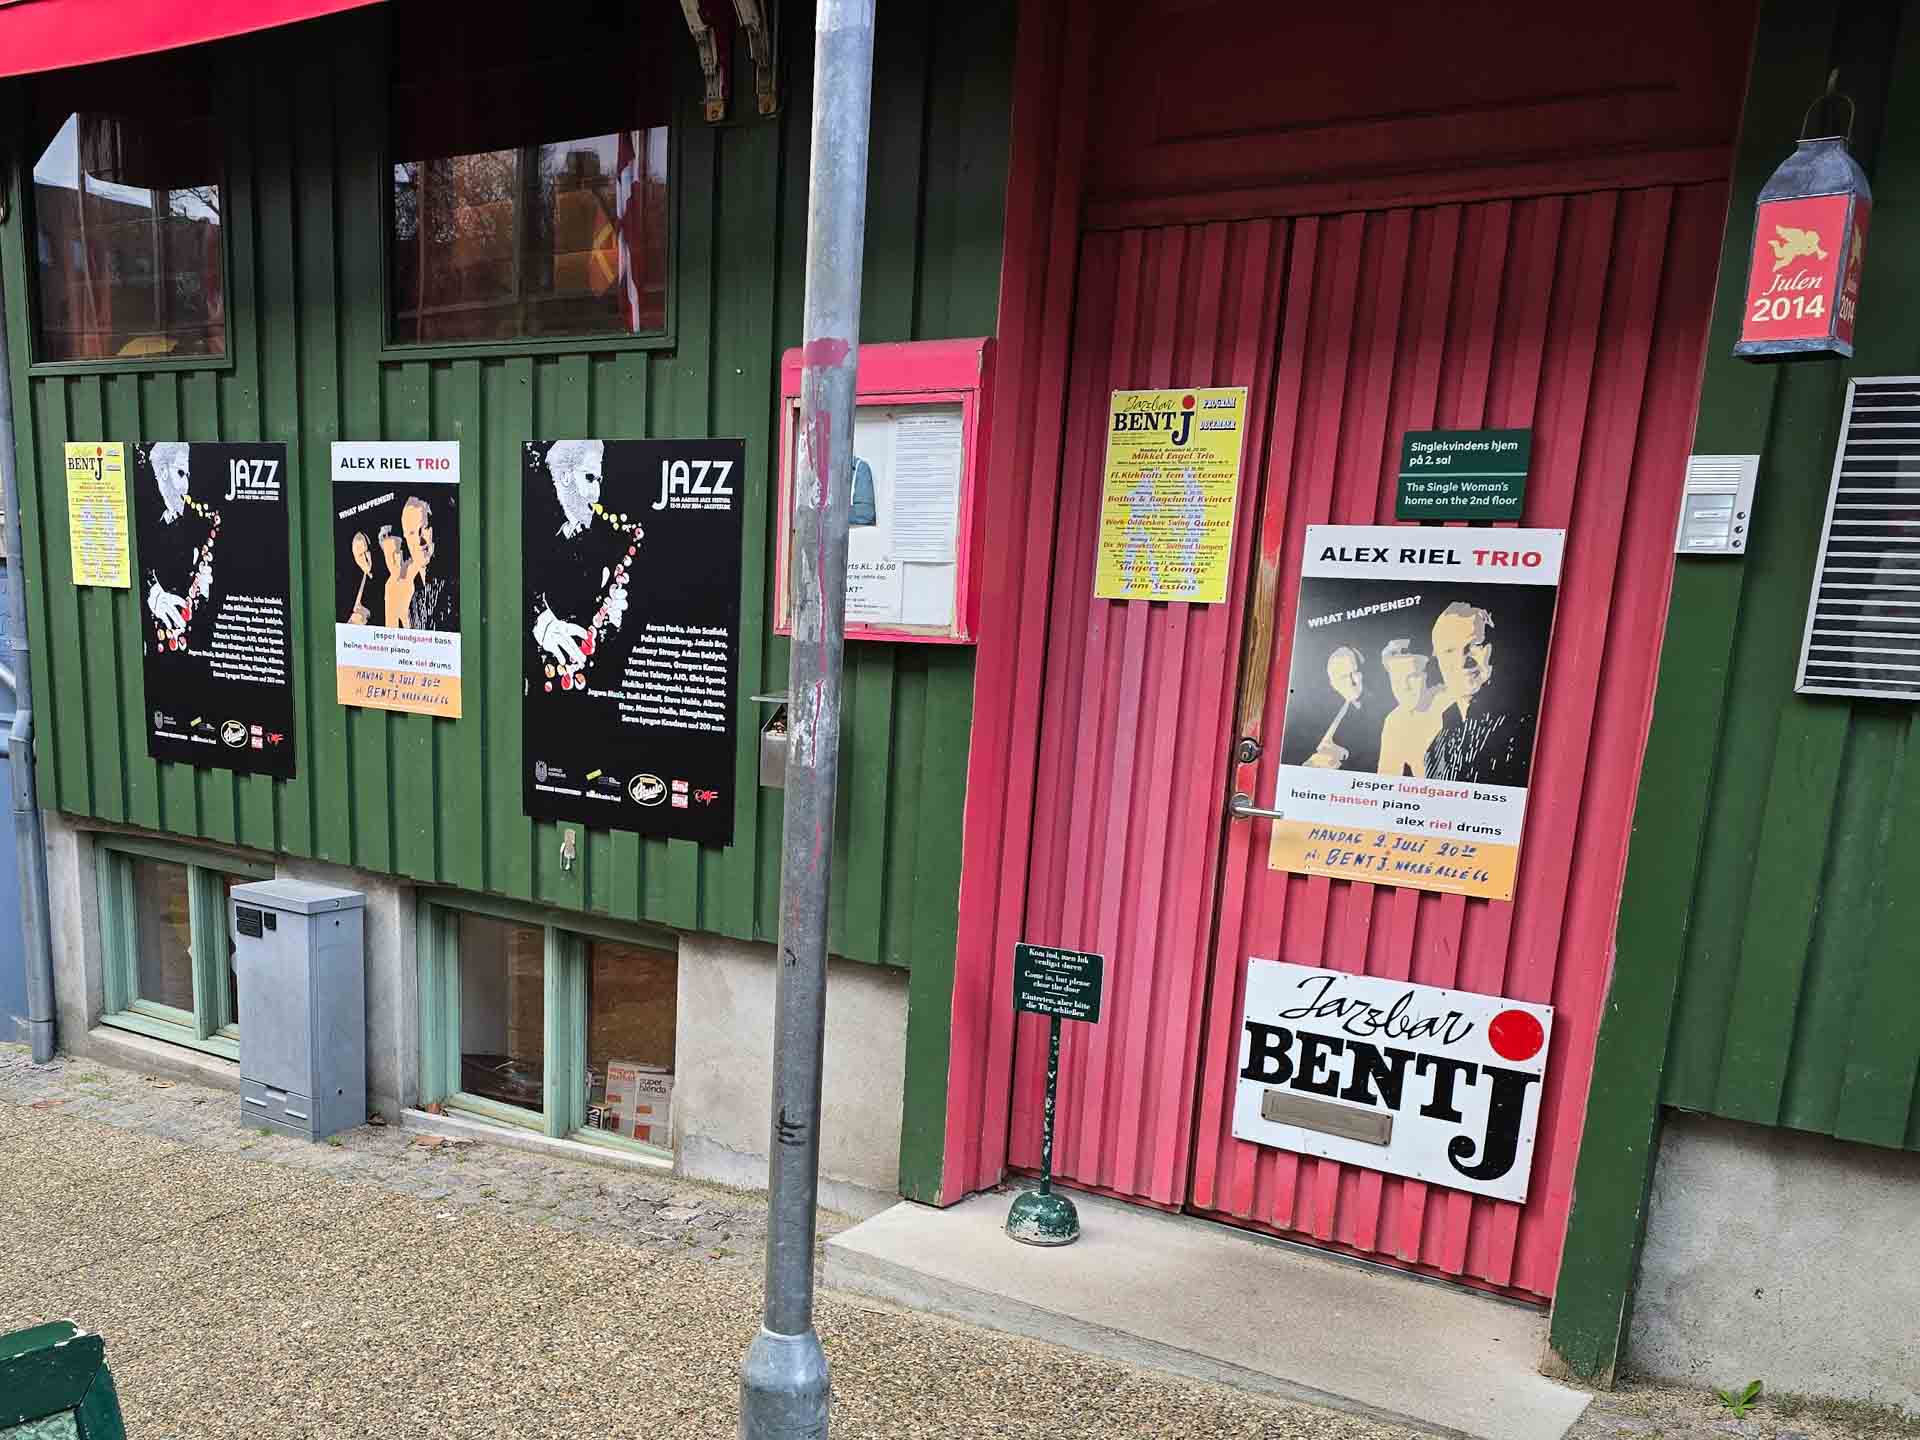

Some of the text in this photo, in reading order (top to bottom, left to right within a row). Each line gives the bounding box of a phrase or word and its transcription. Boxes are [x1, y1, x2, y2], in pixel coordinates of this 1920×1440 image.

[1763, 269, 1823, 295] Julen
[1752, 295, 1825, 322] 2014
[1411, 440, 1518, 453] Singlekvindens hjem
[340, 457, 450, 470] ALEX RIEL TRIO
[1409, 455, 1452, 467] på 2. sal
[225, 459, 280, 501] JAZZ
[652, 460, 734, 510] JAZZ
[1406, 481, 1510, 493] The Single Woman's
[1404, 496, 1518, 505] home on the 2nd floor
[338, 505, 358, 519] WHAT
[1320, 547, 1542, 567] ALEX RIEL TRIO
[1308, 595, 1422, 628] WHAT HAPPENED?
[344, 640, 361, 650] heine
[390, 647, 411, 656] piano
[429, 660, 453, 670] drums
[1290, 788, 1421, 812] heine hansen piano
[1351, 778, 1508, 803] jesper lundgaard bass
[1396, 815, 1503, 836] alex riel drums
[1308, 828, 1362, 844] MANDAG
[1391, 837, 1428, 853] JULI
[1325, 848, 1376, 866] BENT
[1278, 975, 1475, 1045] Jazzbar
